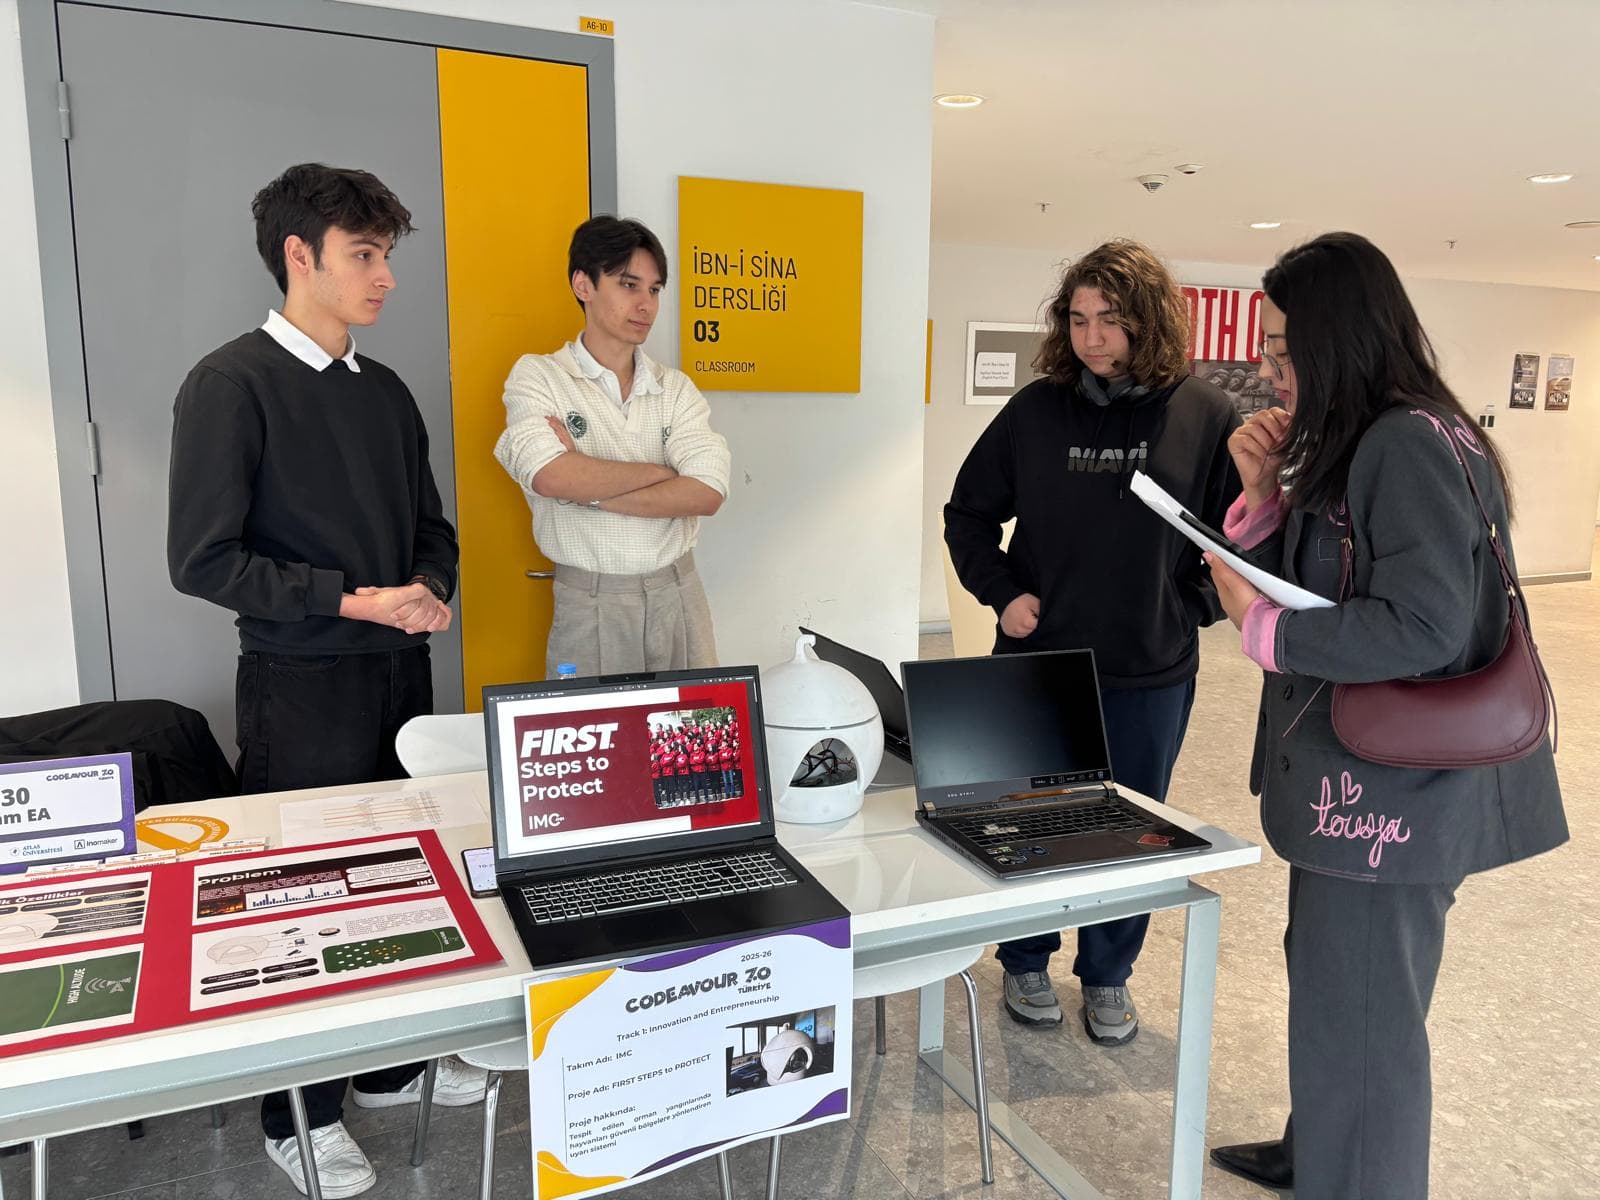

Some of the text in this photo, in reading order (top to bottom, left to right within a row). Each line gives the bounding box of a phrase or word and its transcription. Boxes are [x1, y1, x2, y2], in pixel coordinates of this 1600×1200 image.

[586, 21, 608, 31] A6-10
[693, 245, 797, 280] İBN-İ SİNA
[694, 283, 786, 312] DERSLİĞİ
[694, 319, 720, 343] 03
[695, 360, 756, 373] CLASSROOM
[46, 770, 98, 782] CODEAVOUR
[520, 756, 609, 779] Steps to
[523, 778, 604, 803] Protect
[27, 807, 51, 822] EA
[15, 890, 85, 903] Özellikler
[740, 950, 772, 962] 2025-26
[625, 972, 738, 1014] CODEAVOUR
[738, 982, 772, 995] TÜRKİYE
[617, 1030, 640, 1042] Track
[649, 1014, 692, 1033] Innovation
[693, 1010, 709, 1020] and
[710, 994, 780, 1016] Entrepreneurship
[616, 1049, 633, 1060] IMC
[568, 1090, 591, 1101] Proje
[612, 1077, 636, 1089] FIRST
[637, 1069, 663, 1082] STEPS
[674, 1053, 711, 1071] PROTECT
[569, 1118, 592, 1129] Proje
[569, 1129, 592, 1140] Tespit
[601, 1121, 625, 1132] edilen
[633, 1110, 657, 1122] orman
[609, 1127, 637, 1140] güvenli
[638, 1115, 671, 1130] bölgelere
[671, 1100, 712, 1120] yönlendiren
[590, 1140, 617, 1153] sistemi
